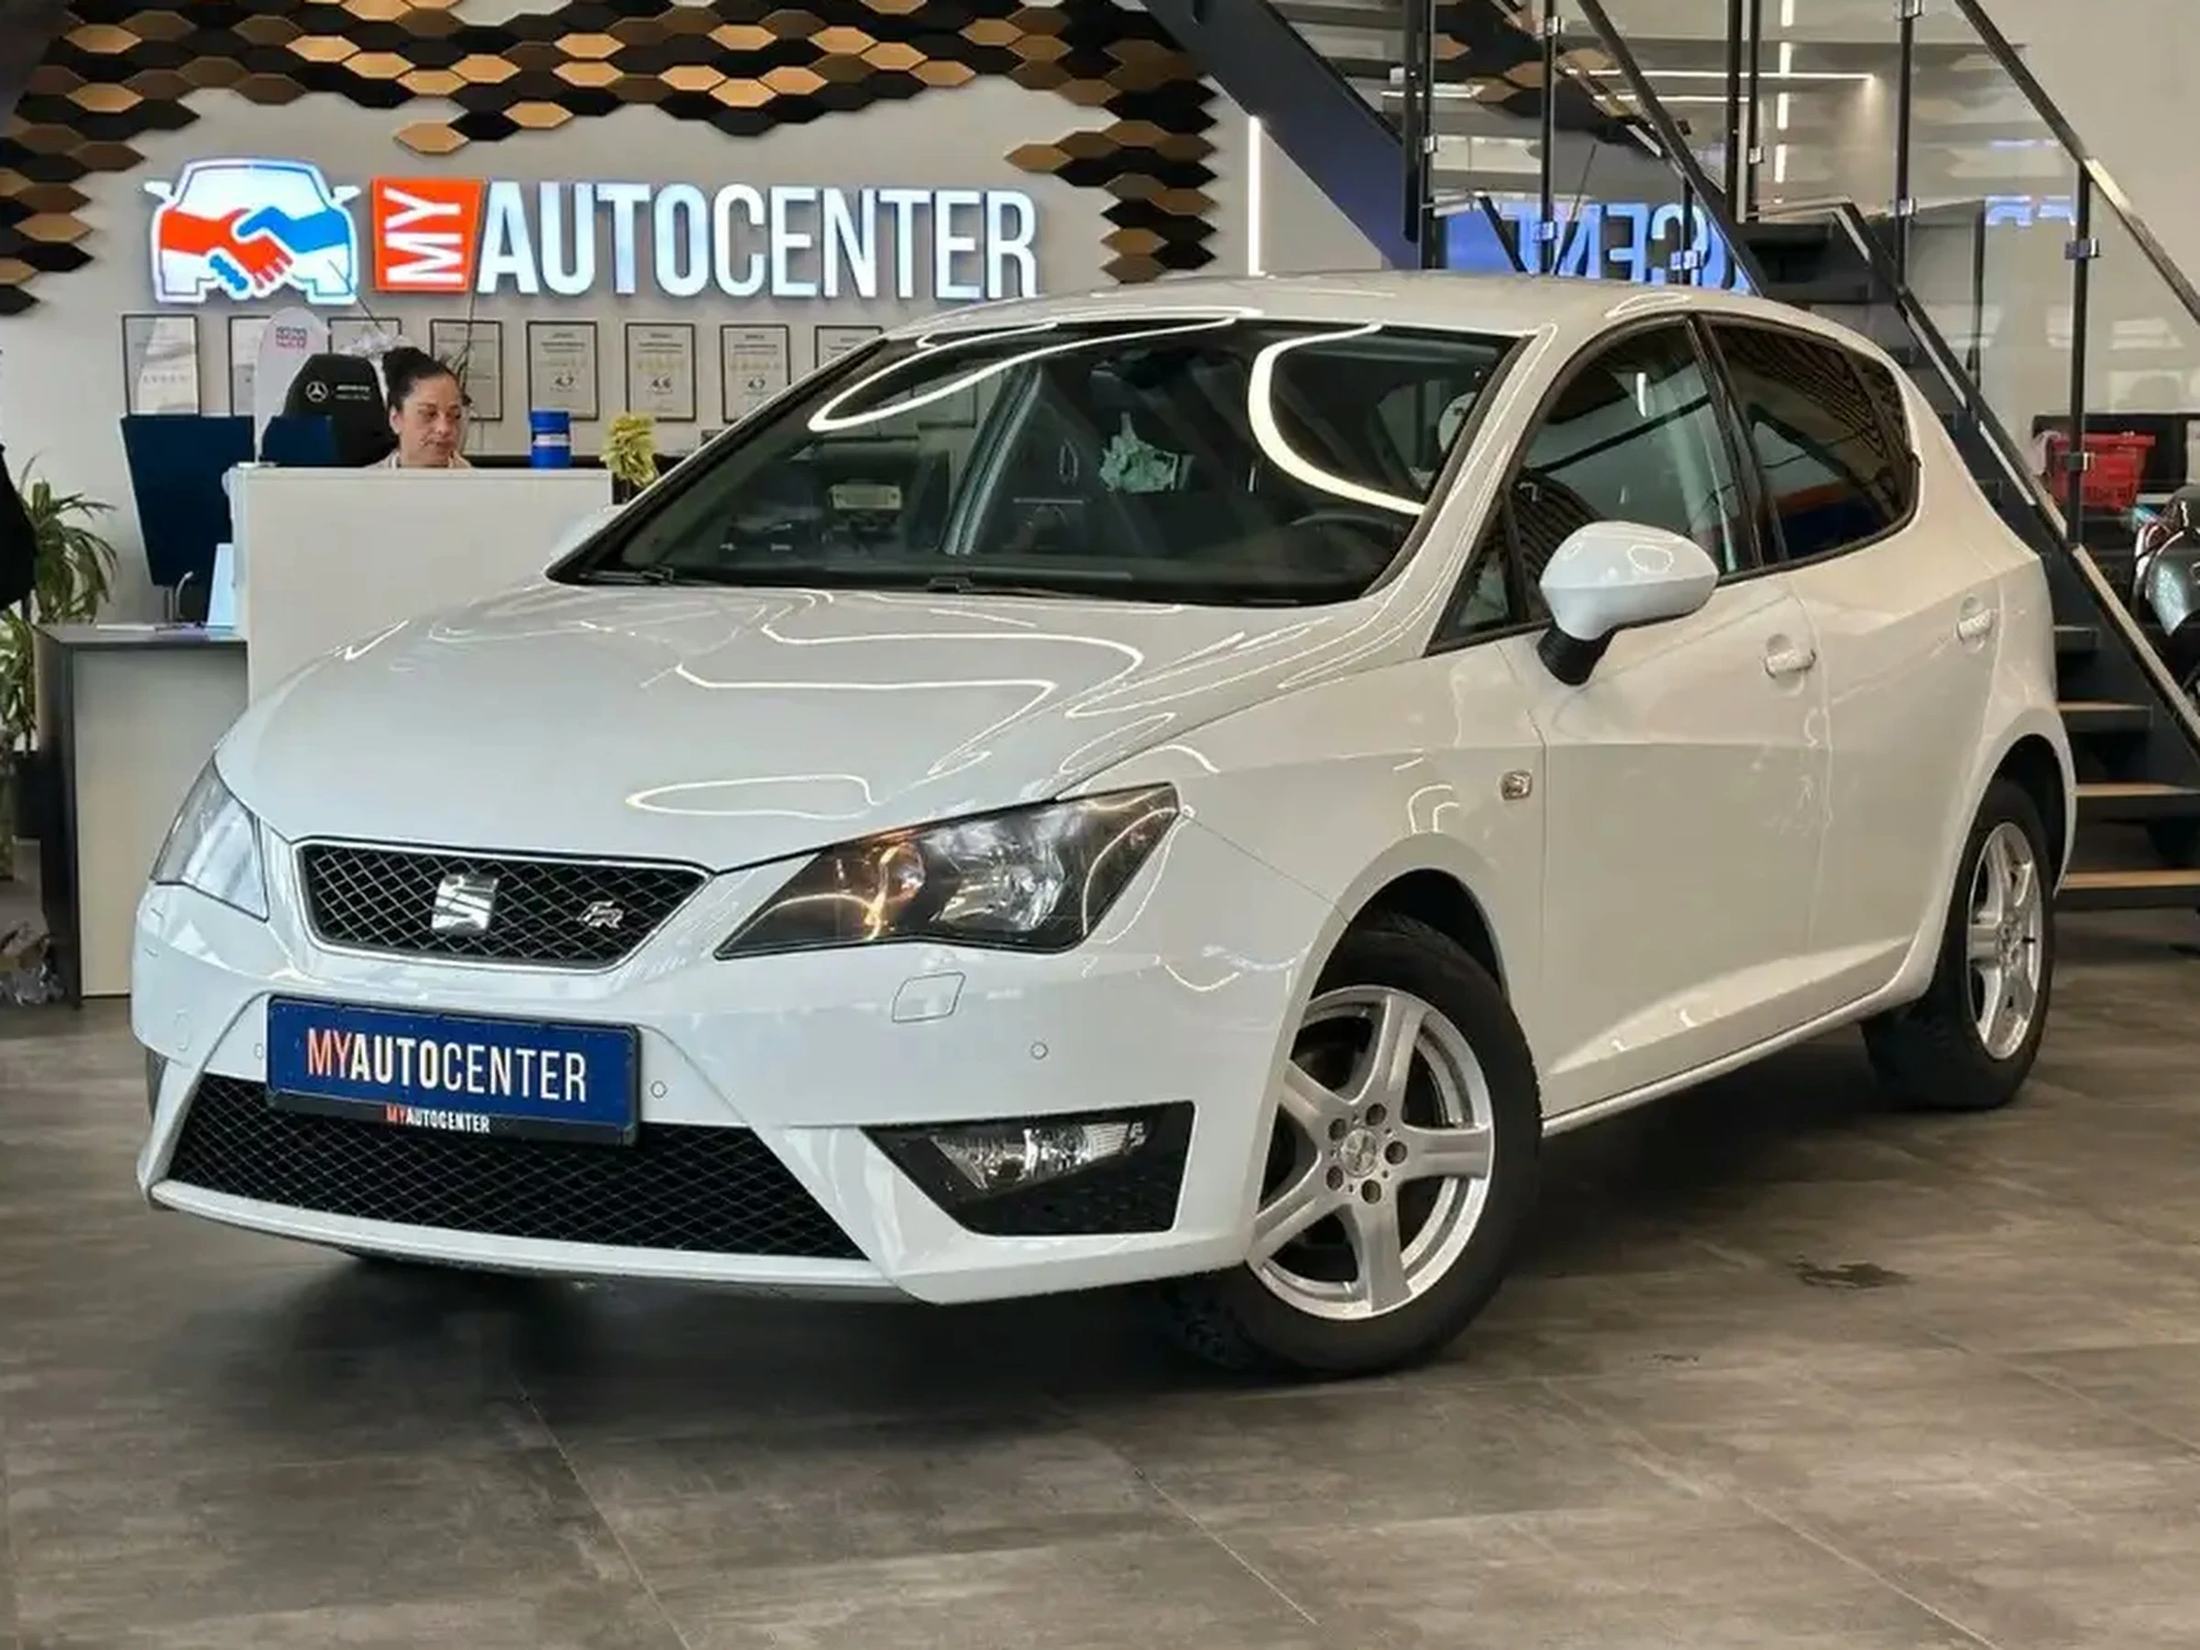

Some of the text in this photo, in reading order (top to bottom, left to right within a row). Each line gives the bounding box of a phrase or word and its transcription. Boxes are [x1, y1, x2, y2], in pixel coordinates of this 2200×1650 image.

[383, 181, 1038, 299] MY AUTOCENTER
[307, 1027, 587, 1103] MYAUTOCENTER
[384, 1103, 492, 1135] MYAUTOCENTER
